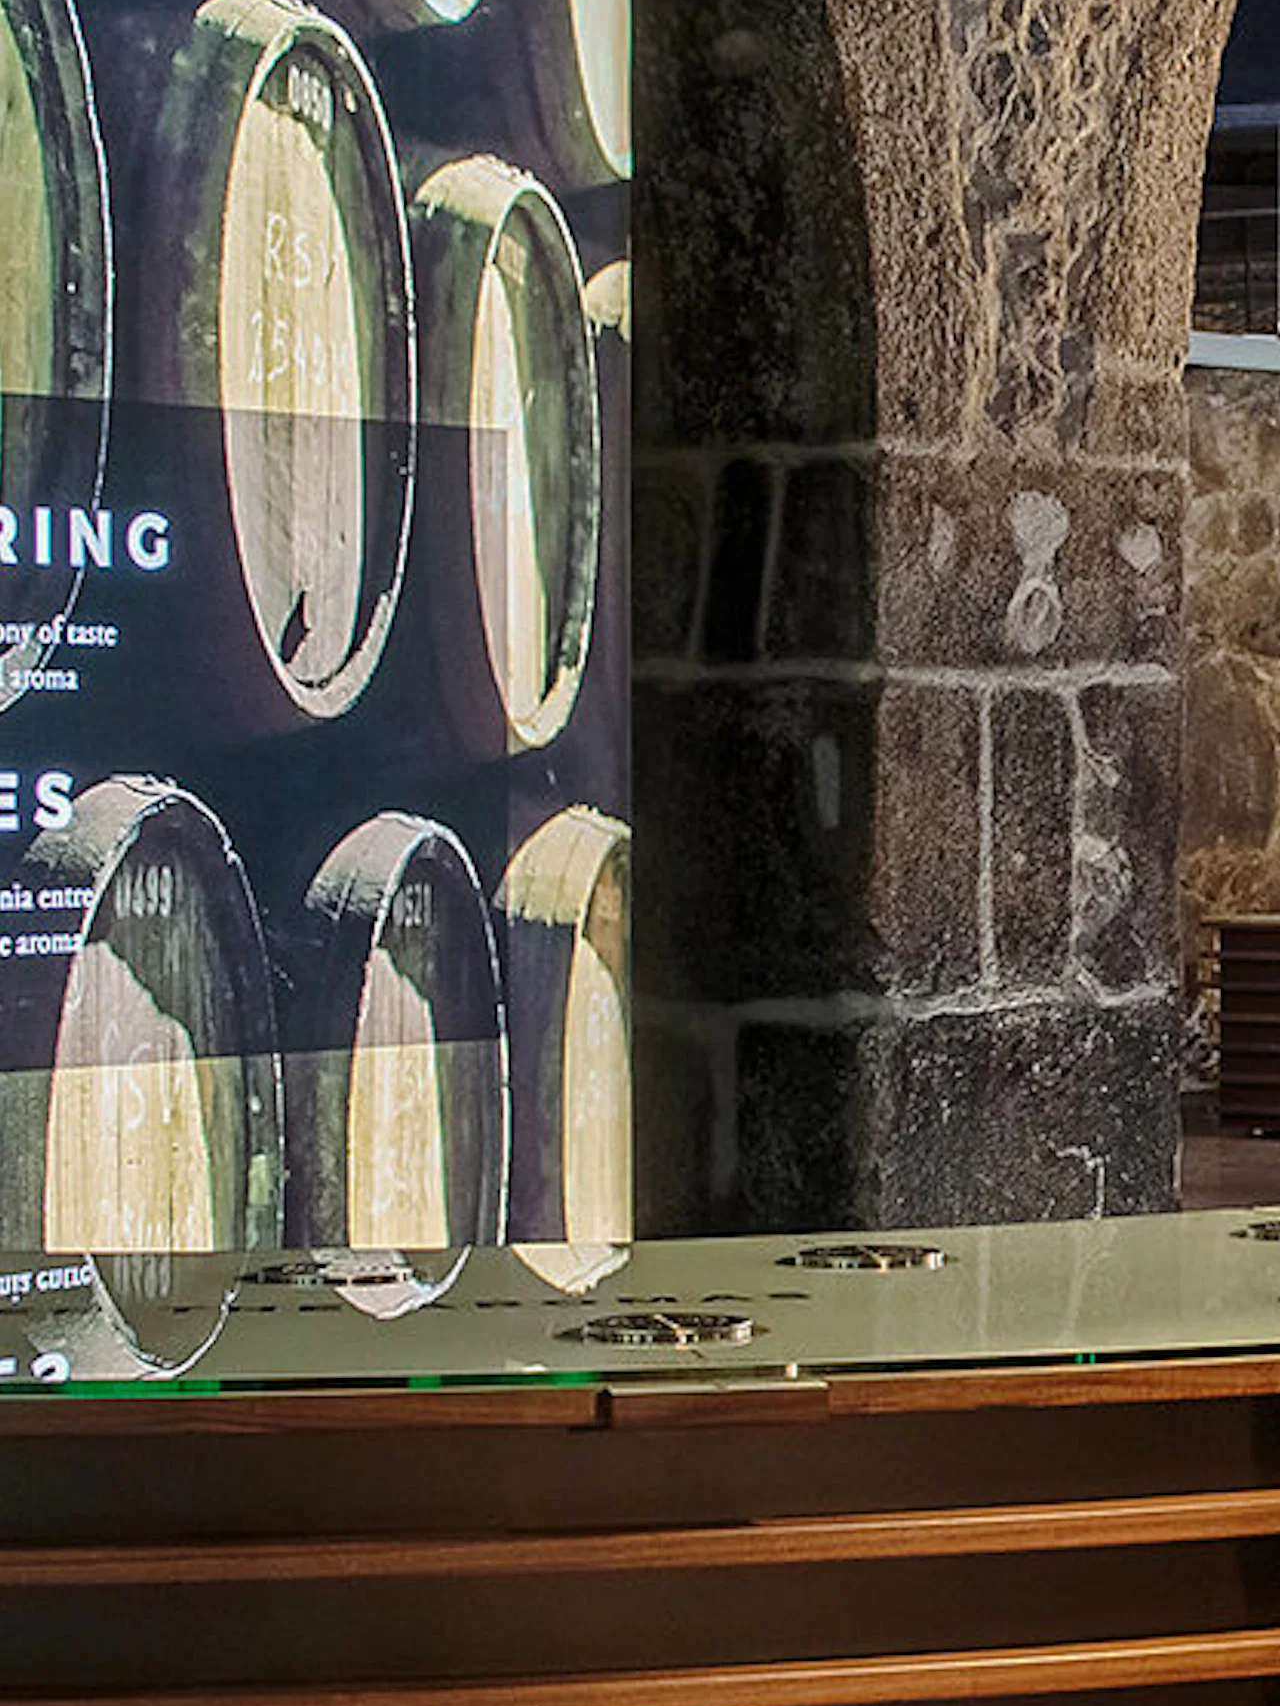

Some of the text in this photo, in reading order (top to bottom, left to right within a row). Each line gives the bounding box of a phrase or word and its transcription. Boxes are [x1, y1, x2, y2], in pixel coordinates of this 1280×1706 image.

[38, 613, 67, 644] of
[67, 624, 120, 647] taste
[10, 668, 80, 690] aroma
[37, 886, 95, 910] entre
